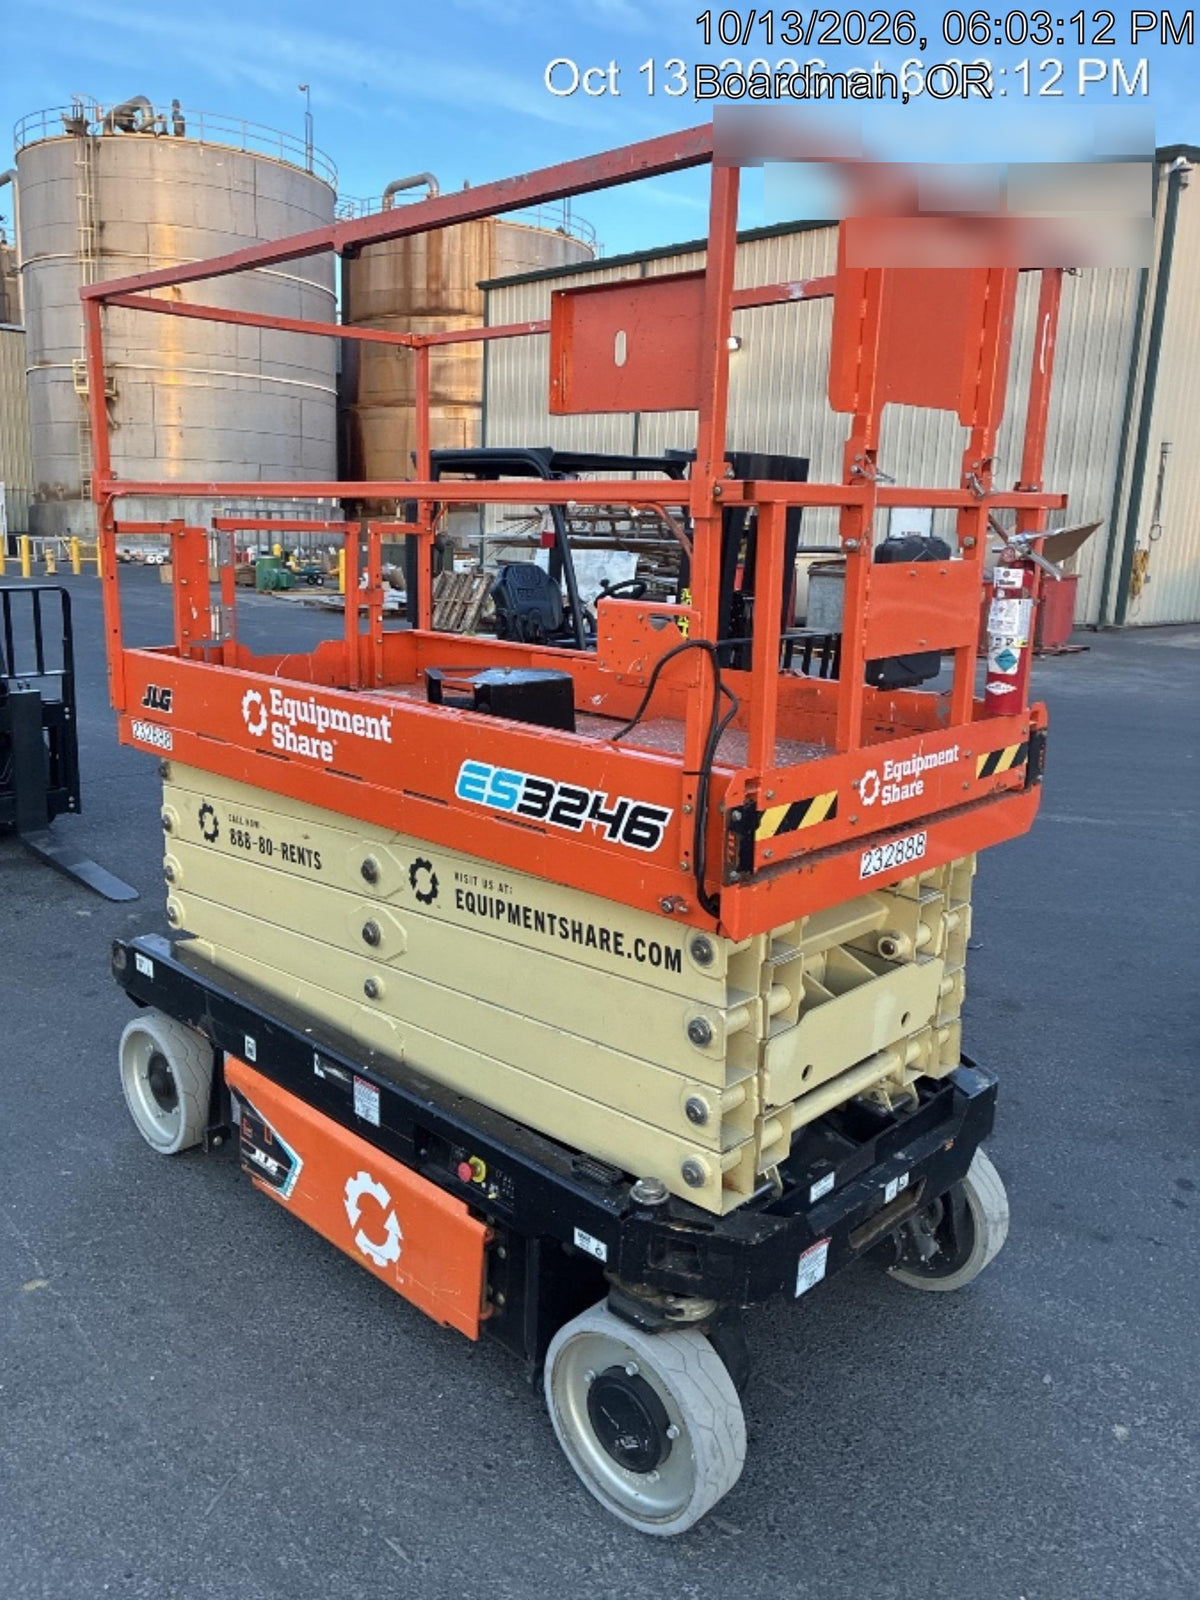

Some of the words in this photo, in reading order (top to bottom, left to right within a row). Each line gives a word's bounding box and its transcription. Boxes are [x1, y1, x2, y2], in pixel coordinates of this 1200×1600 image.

[141, 685, 173, 713] JLG
[269, 687, 393, 744] Equipment
[271, 721, 334, 762] Share
[883, 744, 960, 782] Equipment
[455, 759, 674, 852] ES3246
[881, 779, 925, 806] Share
[229, 827, 322, 870] 888-80-RENTS
[861, 833, 926, 877] 232888
[482, 879, 494, 891] US
[498, 882, 513, 895] AT:
[455, 888, 683, 973] EQUIPMENTSHARE.COM
